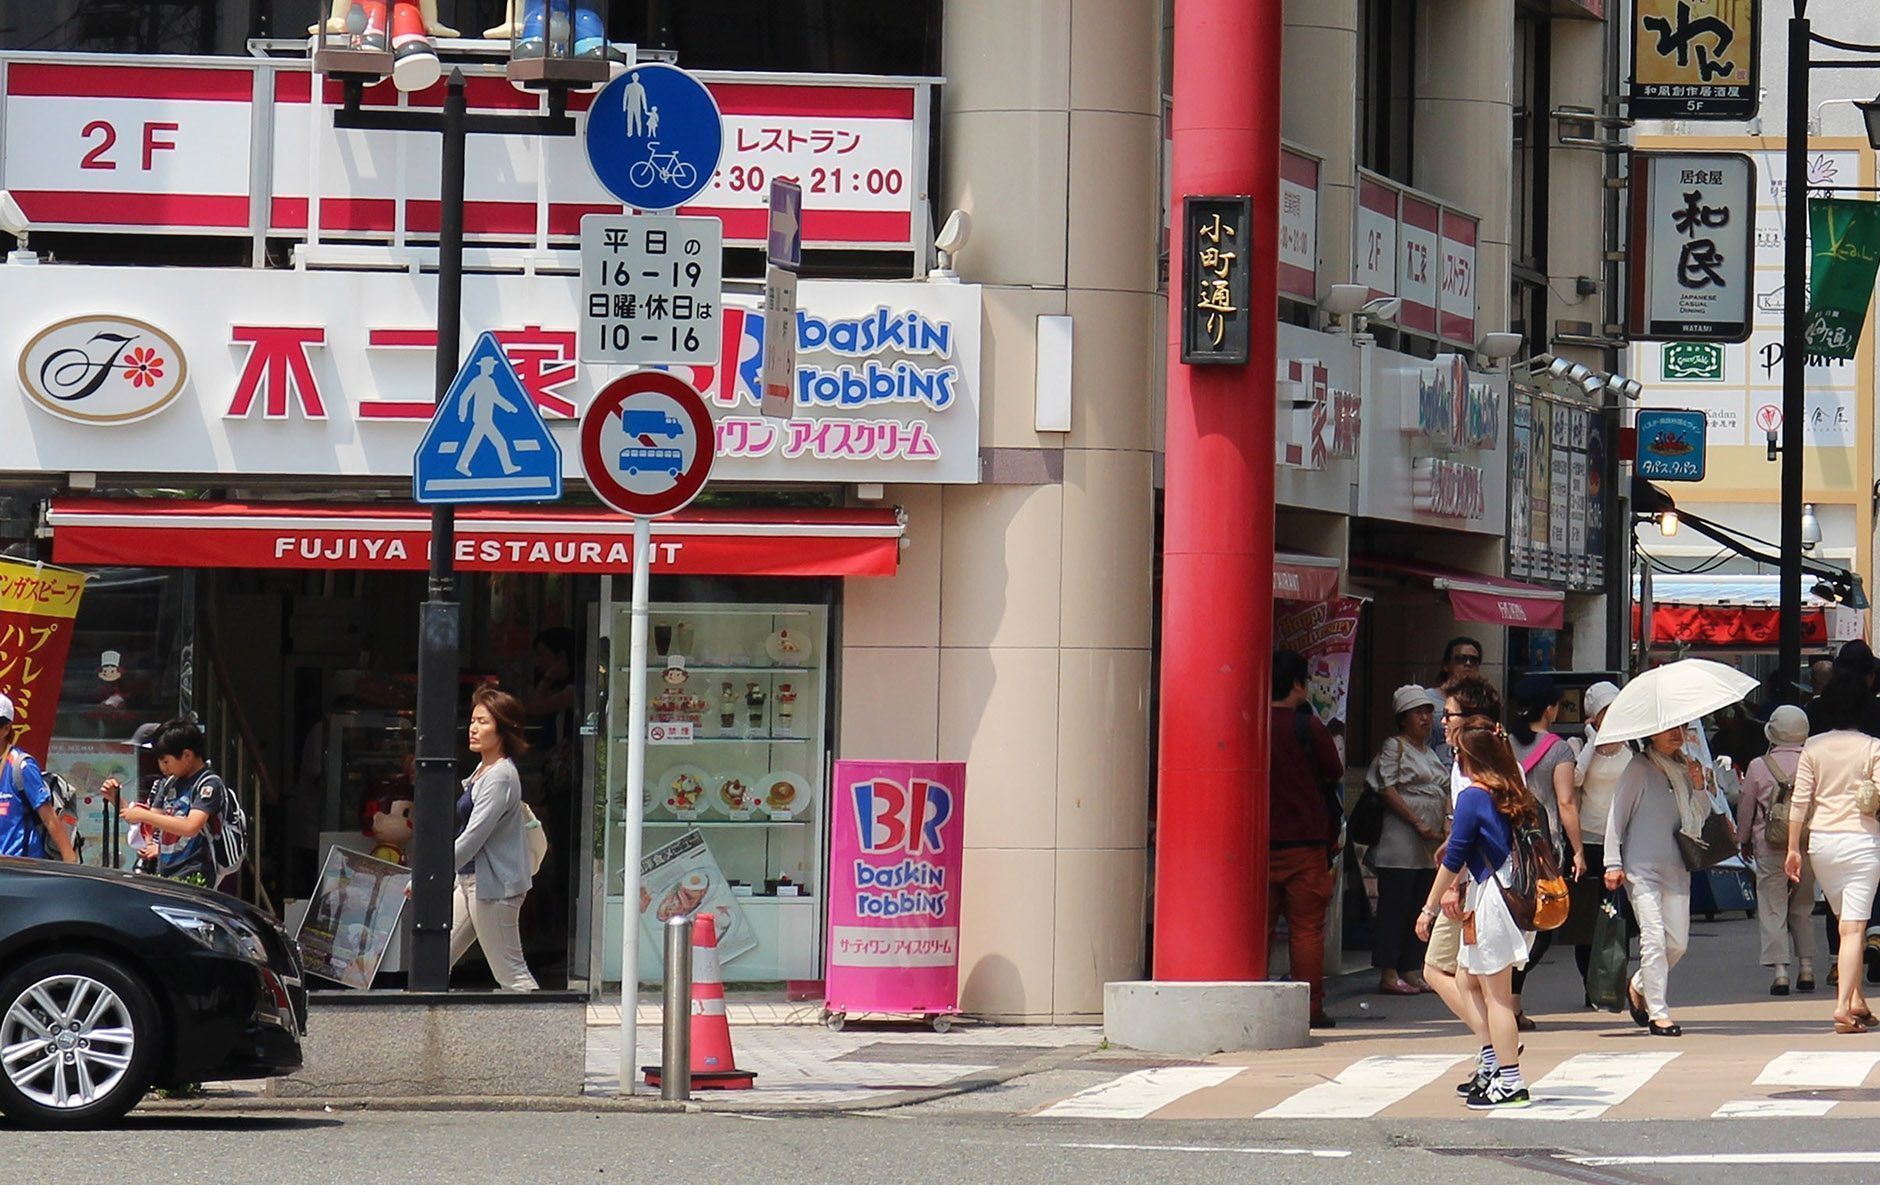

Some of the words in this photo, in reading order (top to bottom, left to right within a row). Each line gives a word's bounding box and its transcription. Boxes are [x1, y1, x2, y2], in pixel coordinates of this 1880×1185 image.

[1643, 0, 1735, 83] わん
[1686, 101, 1704, 112] 5F
[737, 127, 862, 154] レストラン
[1680, 170, 1723, 185] 居食屋
[603, 228, 702, 256] 平日の
[1368, 229, 1382, 272] 2F
[1671, 190, 1730, 289] 和民
[1197, 213, 1238, 348] 小町通り
[788, 422, 936, 455] アイスクリーム
[274, 537, 408, 561] FUJIYA
[427, 538, 683, 564] ESTAURAT
[853, 779, 952, 855] BR
[840, 938, 891, 955] サーティワン
[894, 938, 953, 955] アイスクリーム
